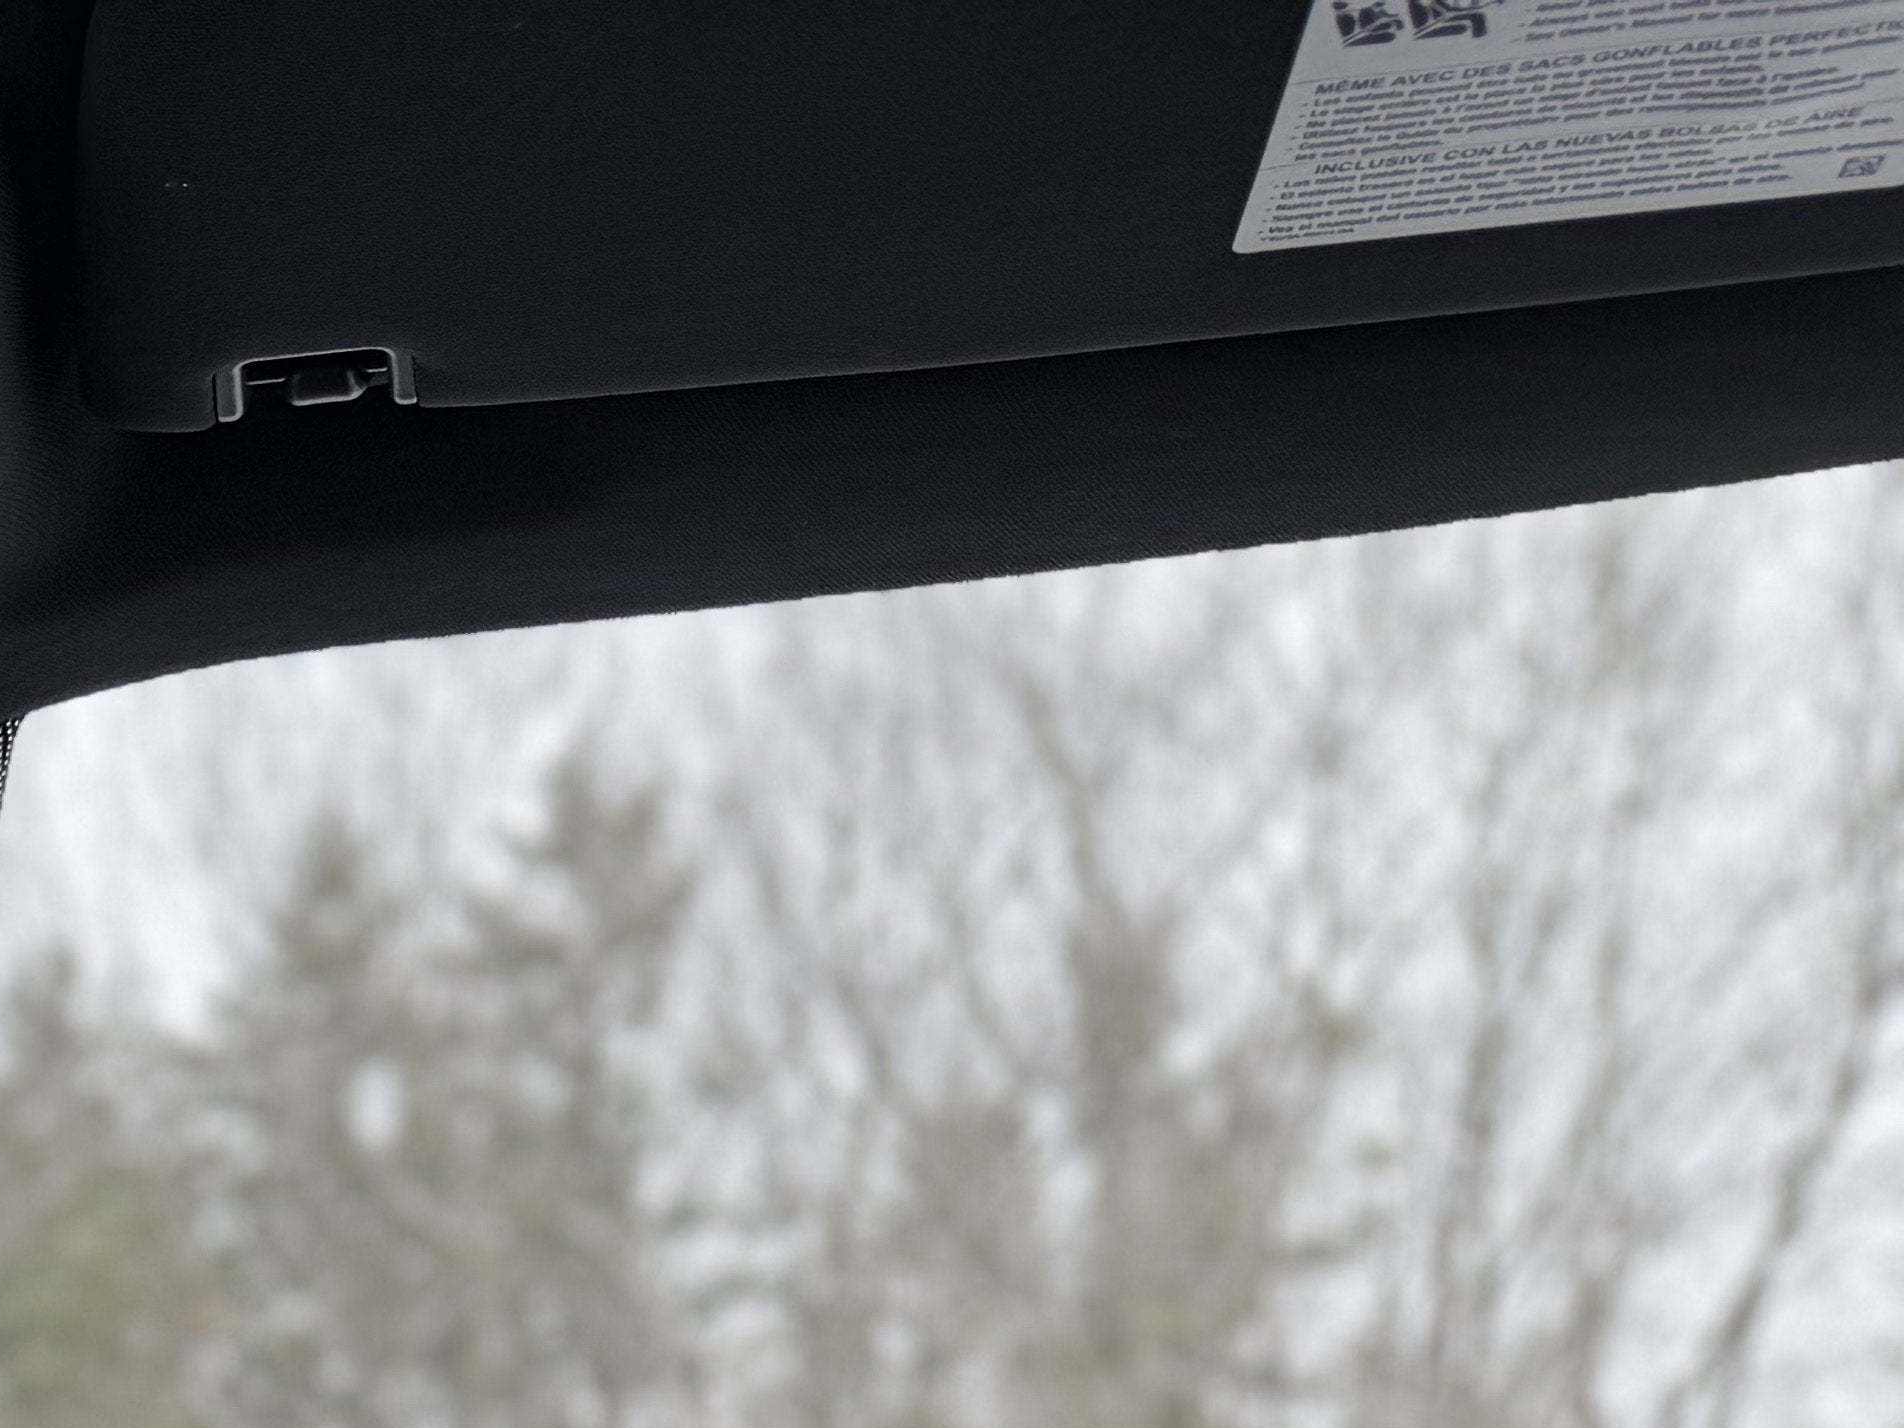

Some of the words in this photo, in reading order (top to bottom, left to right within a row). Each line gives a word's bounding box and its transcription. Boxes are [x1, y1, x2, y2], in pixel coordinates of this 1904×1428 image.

[1390, 70, 1454, 87] AVEC
[1461, 63, 1512, 80] DES
[1517, 54, 1587, 73] SACS
[1592, 36, 1763, 63] GONFLABLES
[1315, 152, 1438, 175] INCLUSIVE
[1443, 146, 1495, 162] CON
[1501, 139, 1548, 156] LAS
[1554, 128, 1652, 149] NUEVAS
[1658, 119, 1759, 139] BOLSAS
